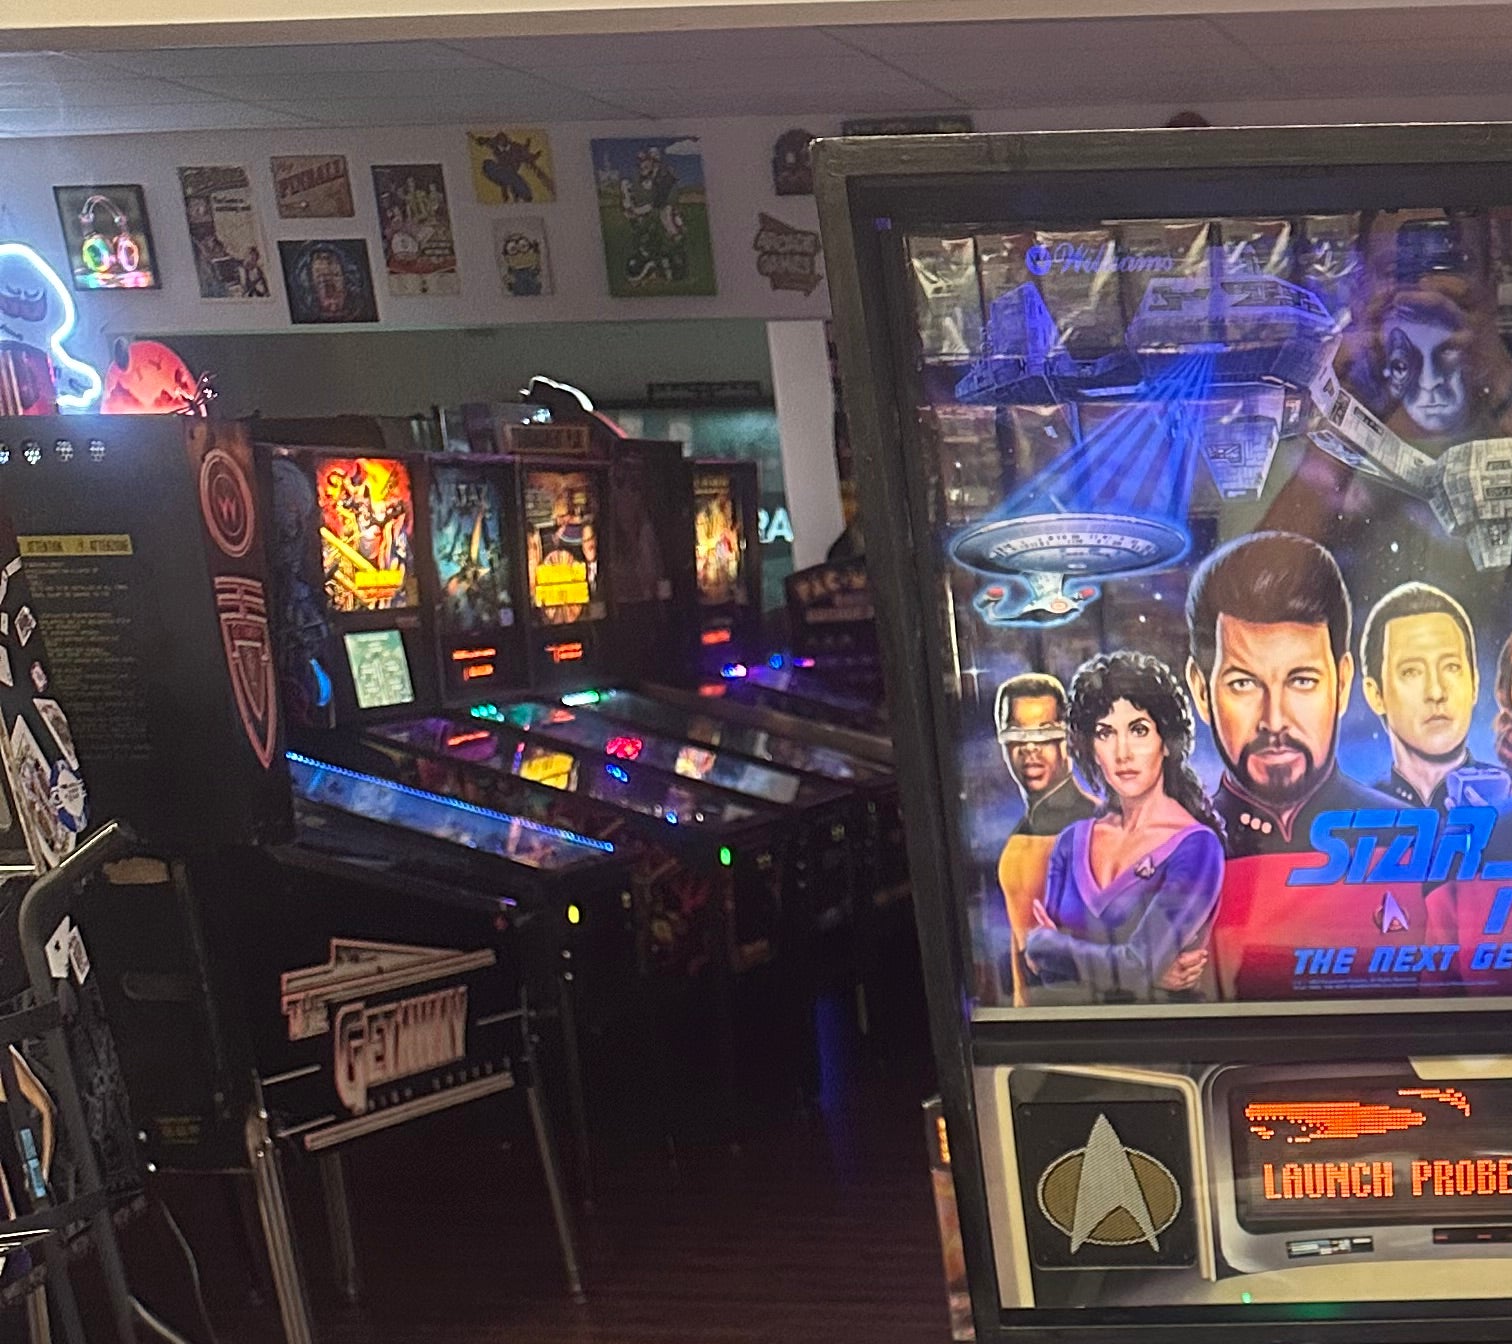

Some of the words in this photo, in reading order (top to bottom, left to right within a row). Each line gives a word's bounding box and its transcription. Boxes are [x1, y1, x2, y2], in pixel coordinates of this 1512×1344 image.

[1288, 806, 1497, 885] STAR
[1293, 948, 1355, 975] THE
[1369, 944, 1460, 973] NEXT
[1264, 1158, 1394, 1200] LAUNCH
